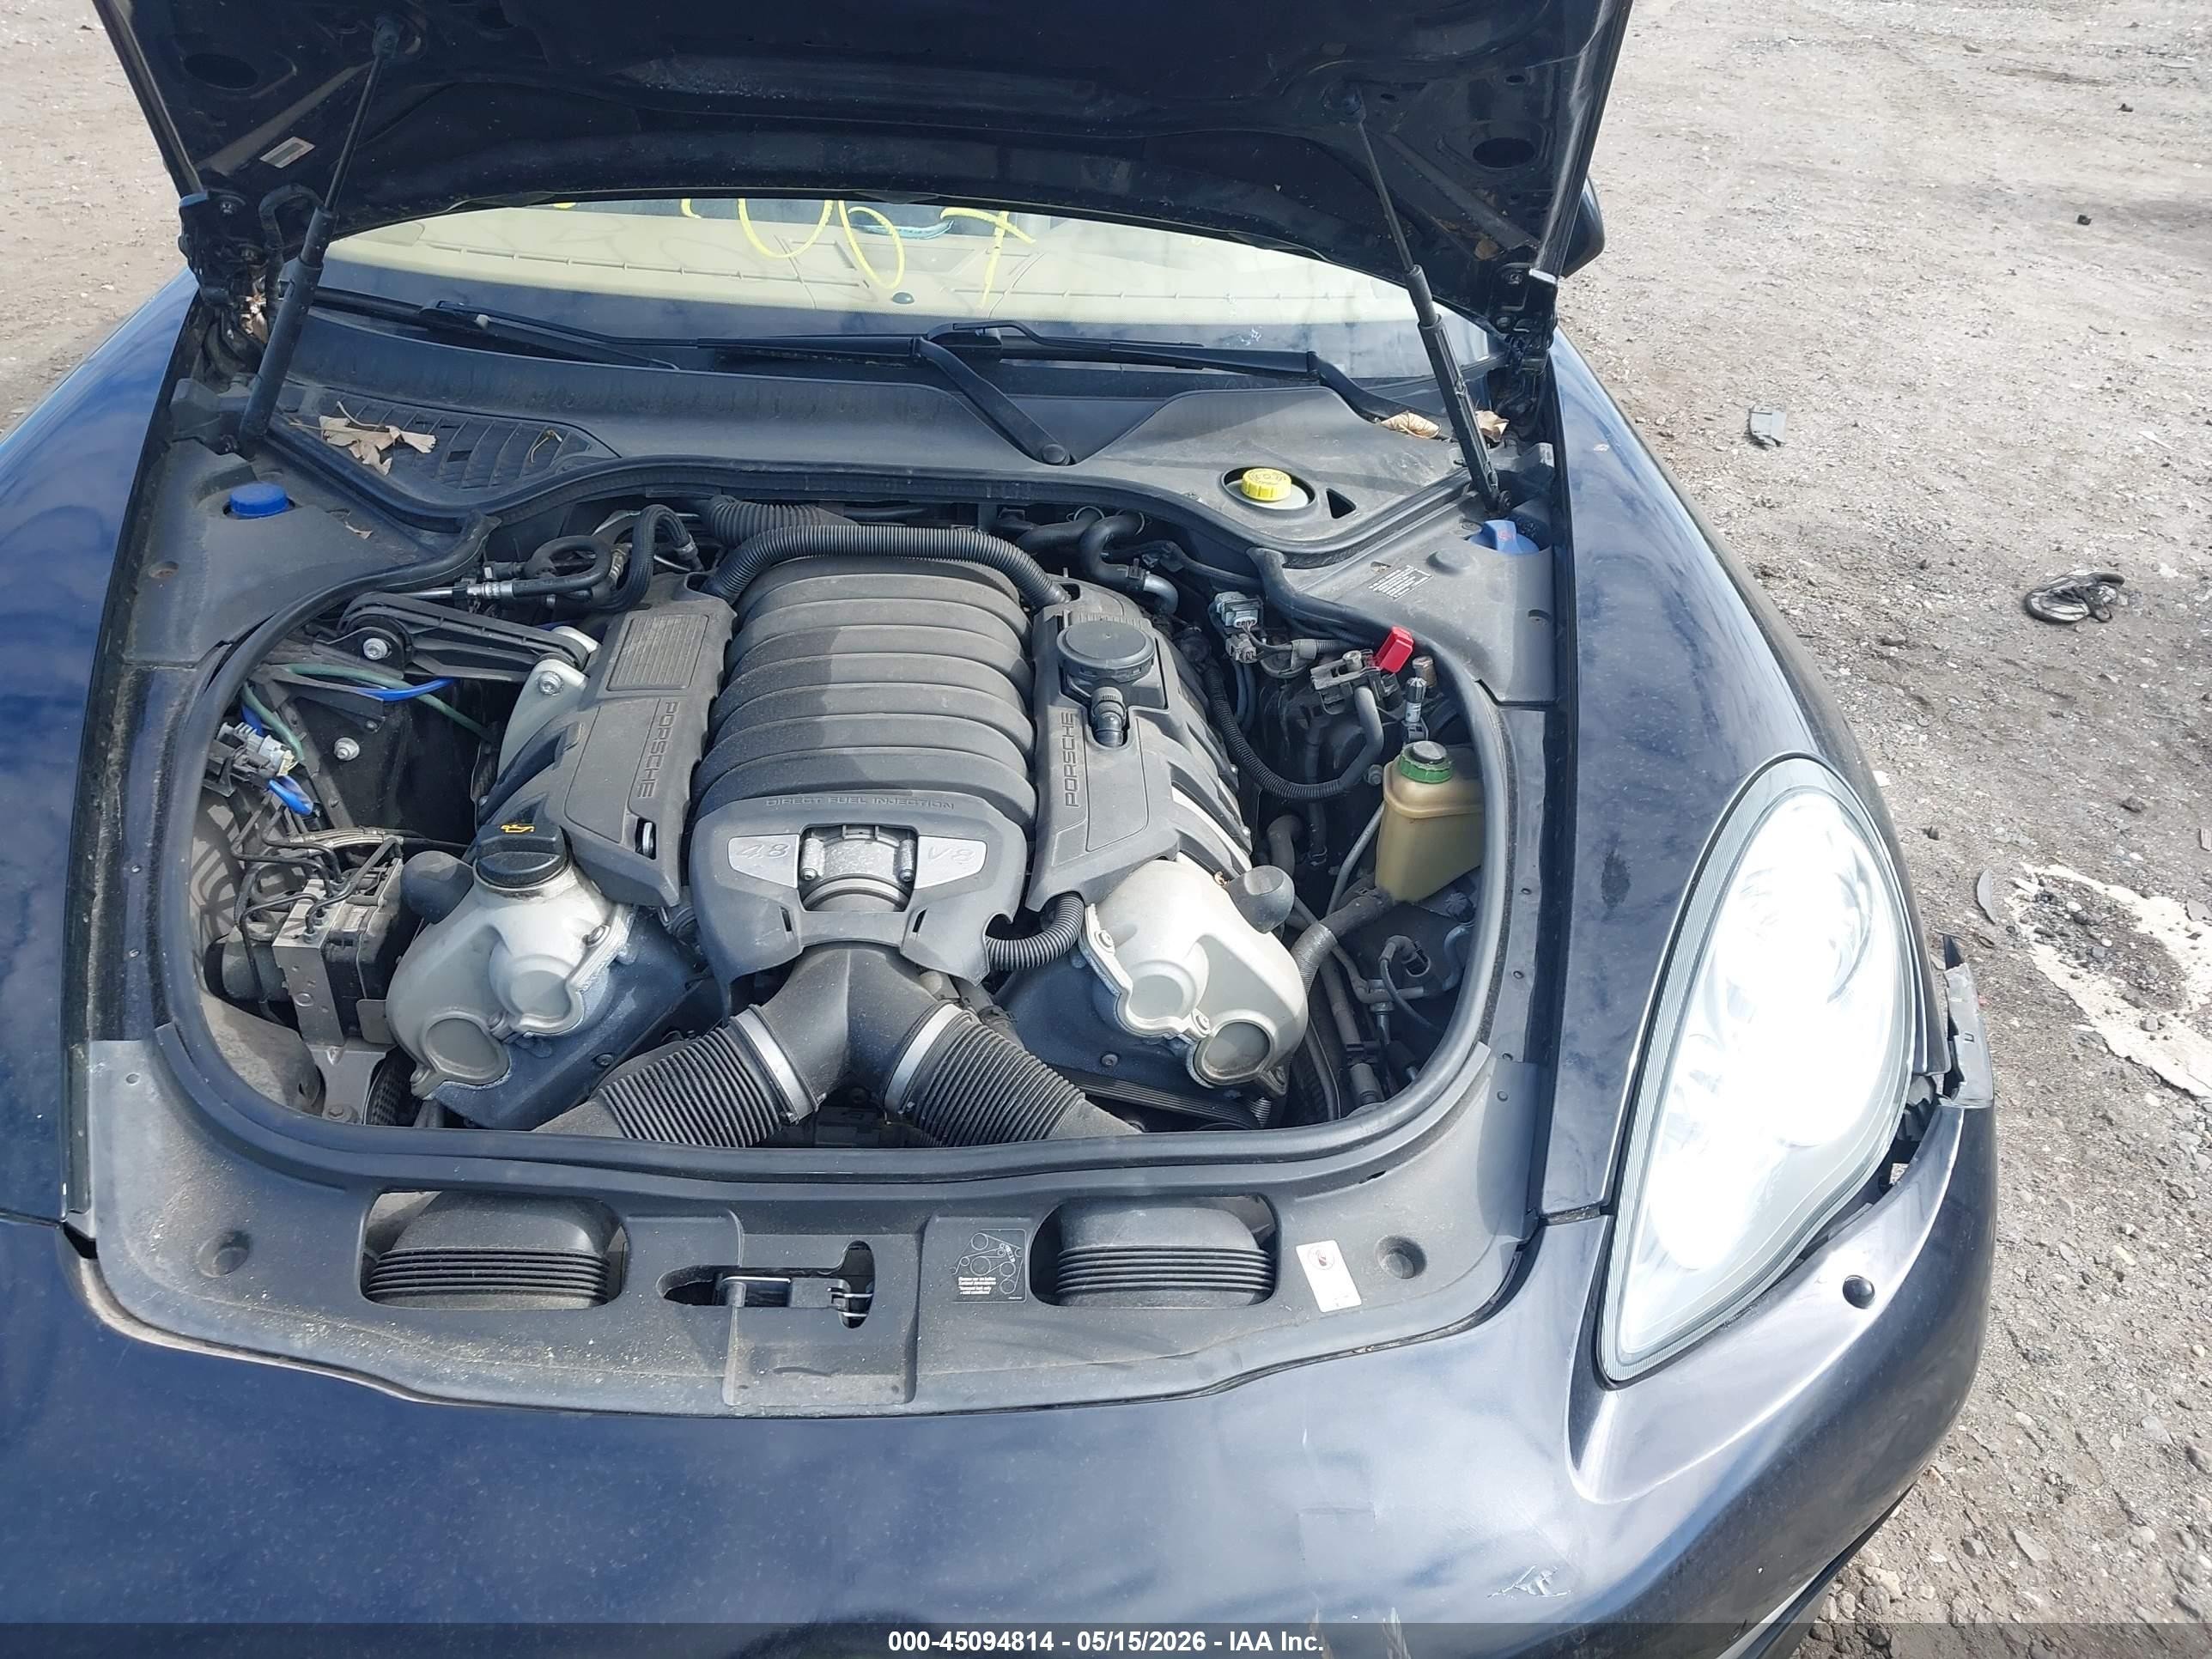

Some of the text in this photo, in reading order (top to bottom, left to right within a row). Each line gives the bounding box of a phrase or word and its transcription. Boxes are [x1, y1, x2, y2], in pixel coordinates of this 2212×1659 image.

[636, 700, 680, 799] PORSCHE
[1060, 711, 1079, 808] PORSCHE
[765, 796, 954, 810] DIRECT FUEL INJECTION
[927, 846, 976, 864] V8
